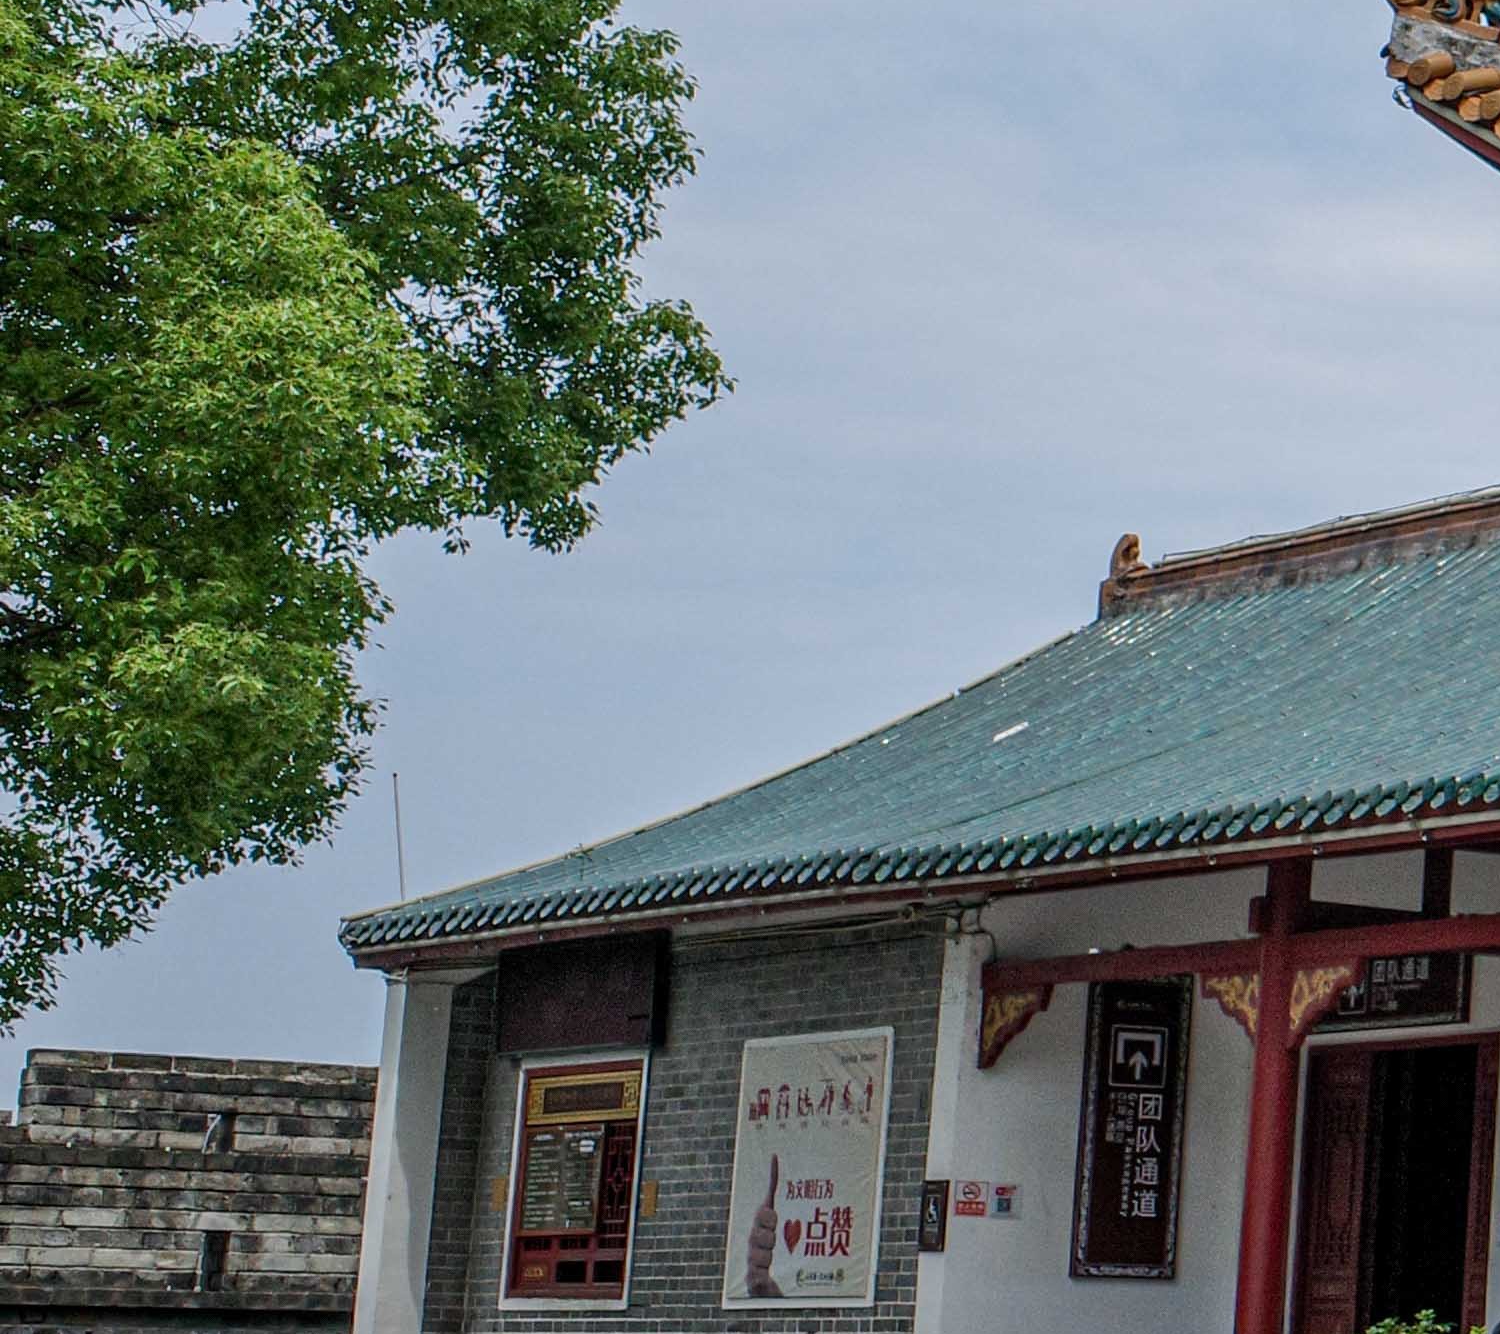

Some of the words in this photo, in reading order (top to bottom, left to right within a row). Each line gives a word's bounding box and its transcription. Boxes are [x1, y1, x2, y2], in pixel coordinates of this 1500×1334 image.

[1131, 1093, 1163, 1218] 团队通道
[804, 1206, 853, 1257] 点赞
